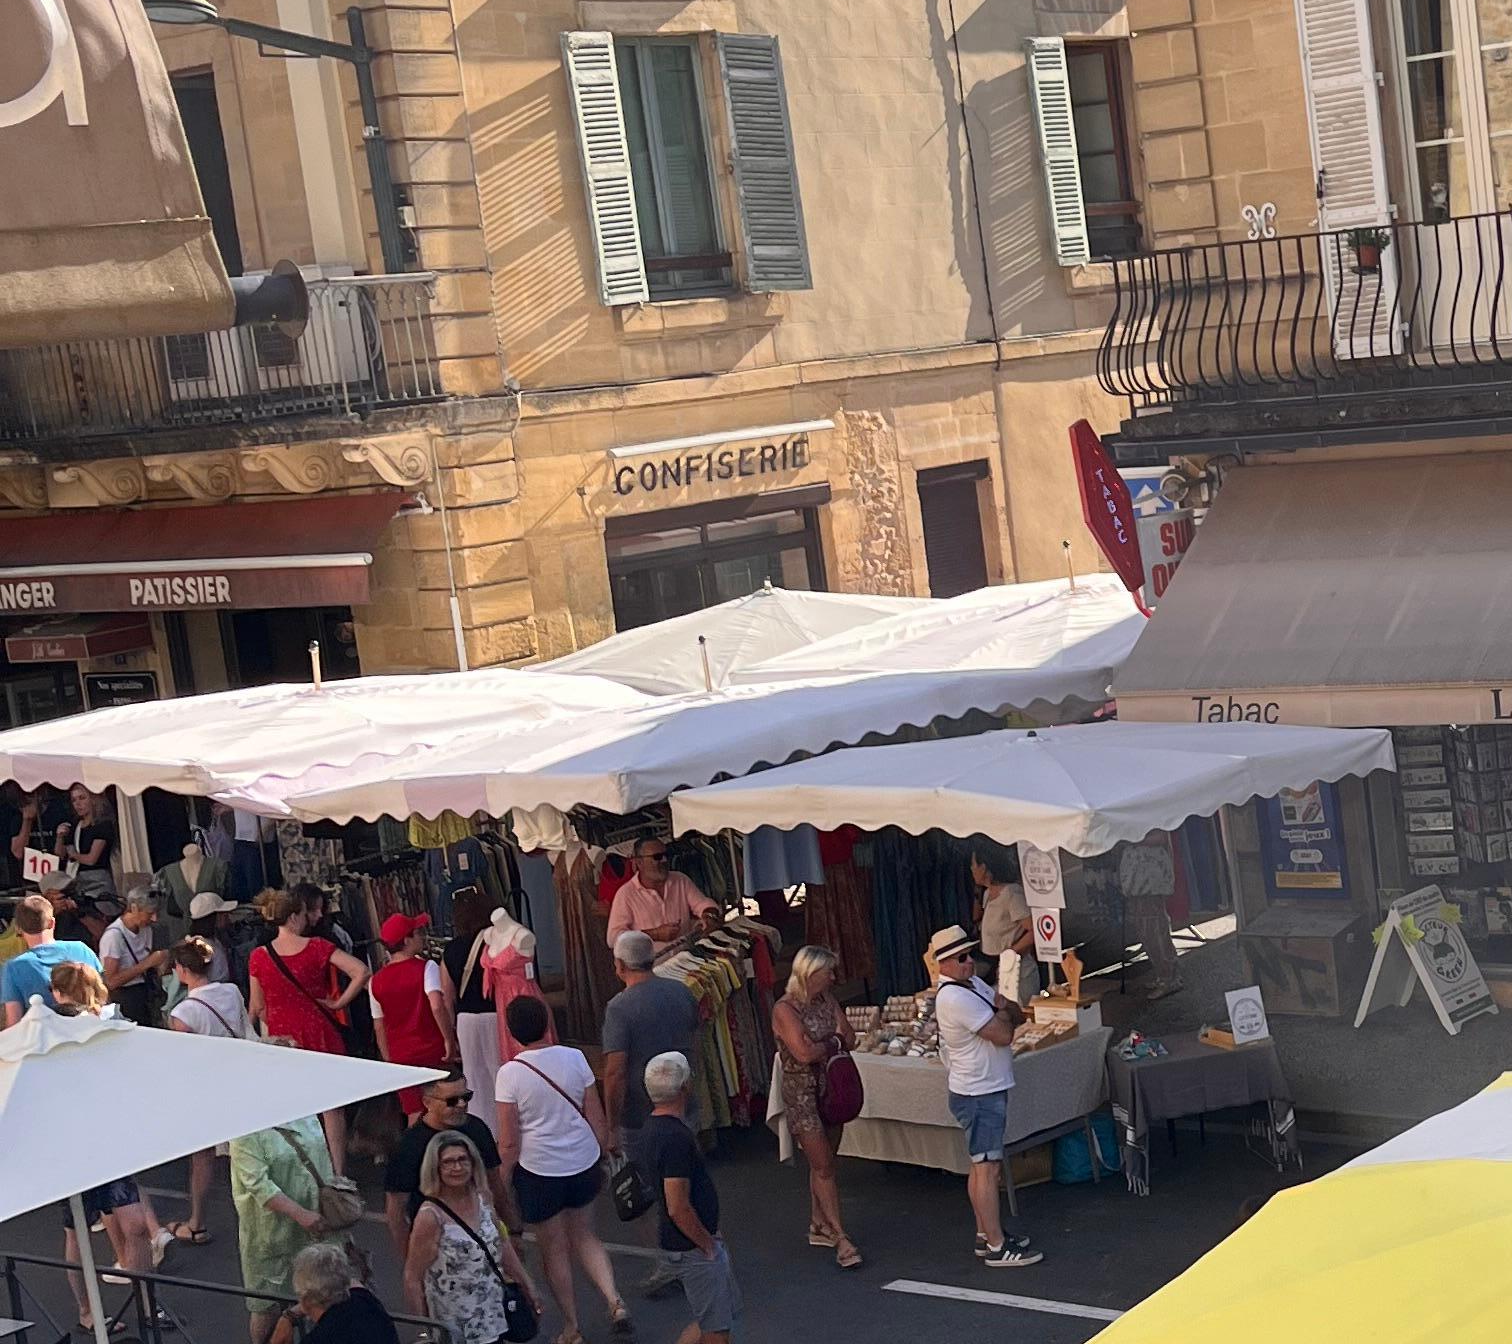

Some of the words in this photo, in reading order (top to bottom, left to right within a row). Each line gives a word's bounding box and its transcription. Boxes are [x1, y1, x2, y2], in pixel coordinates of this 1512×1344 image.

[614, 439, 809, 495] CONFISERIE
[1095, 468, 1128, 544] TABAC
[0, 582, 56, 609] NGER
[129, 575, 232, 605] PATISSIER
[1191, 696, 1280, 724] Tabac
[28, 855, 51, 877] 10
